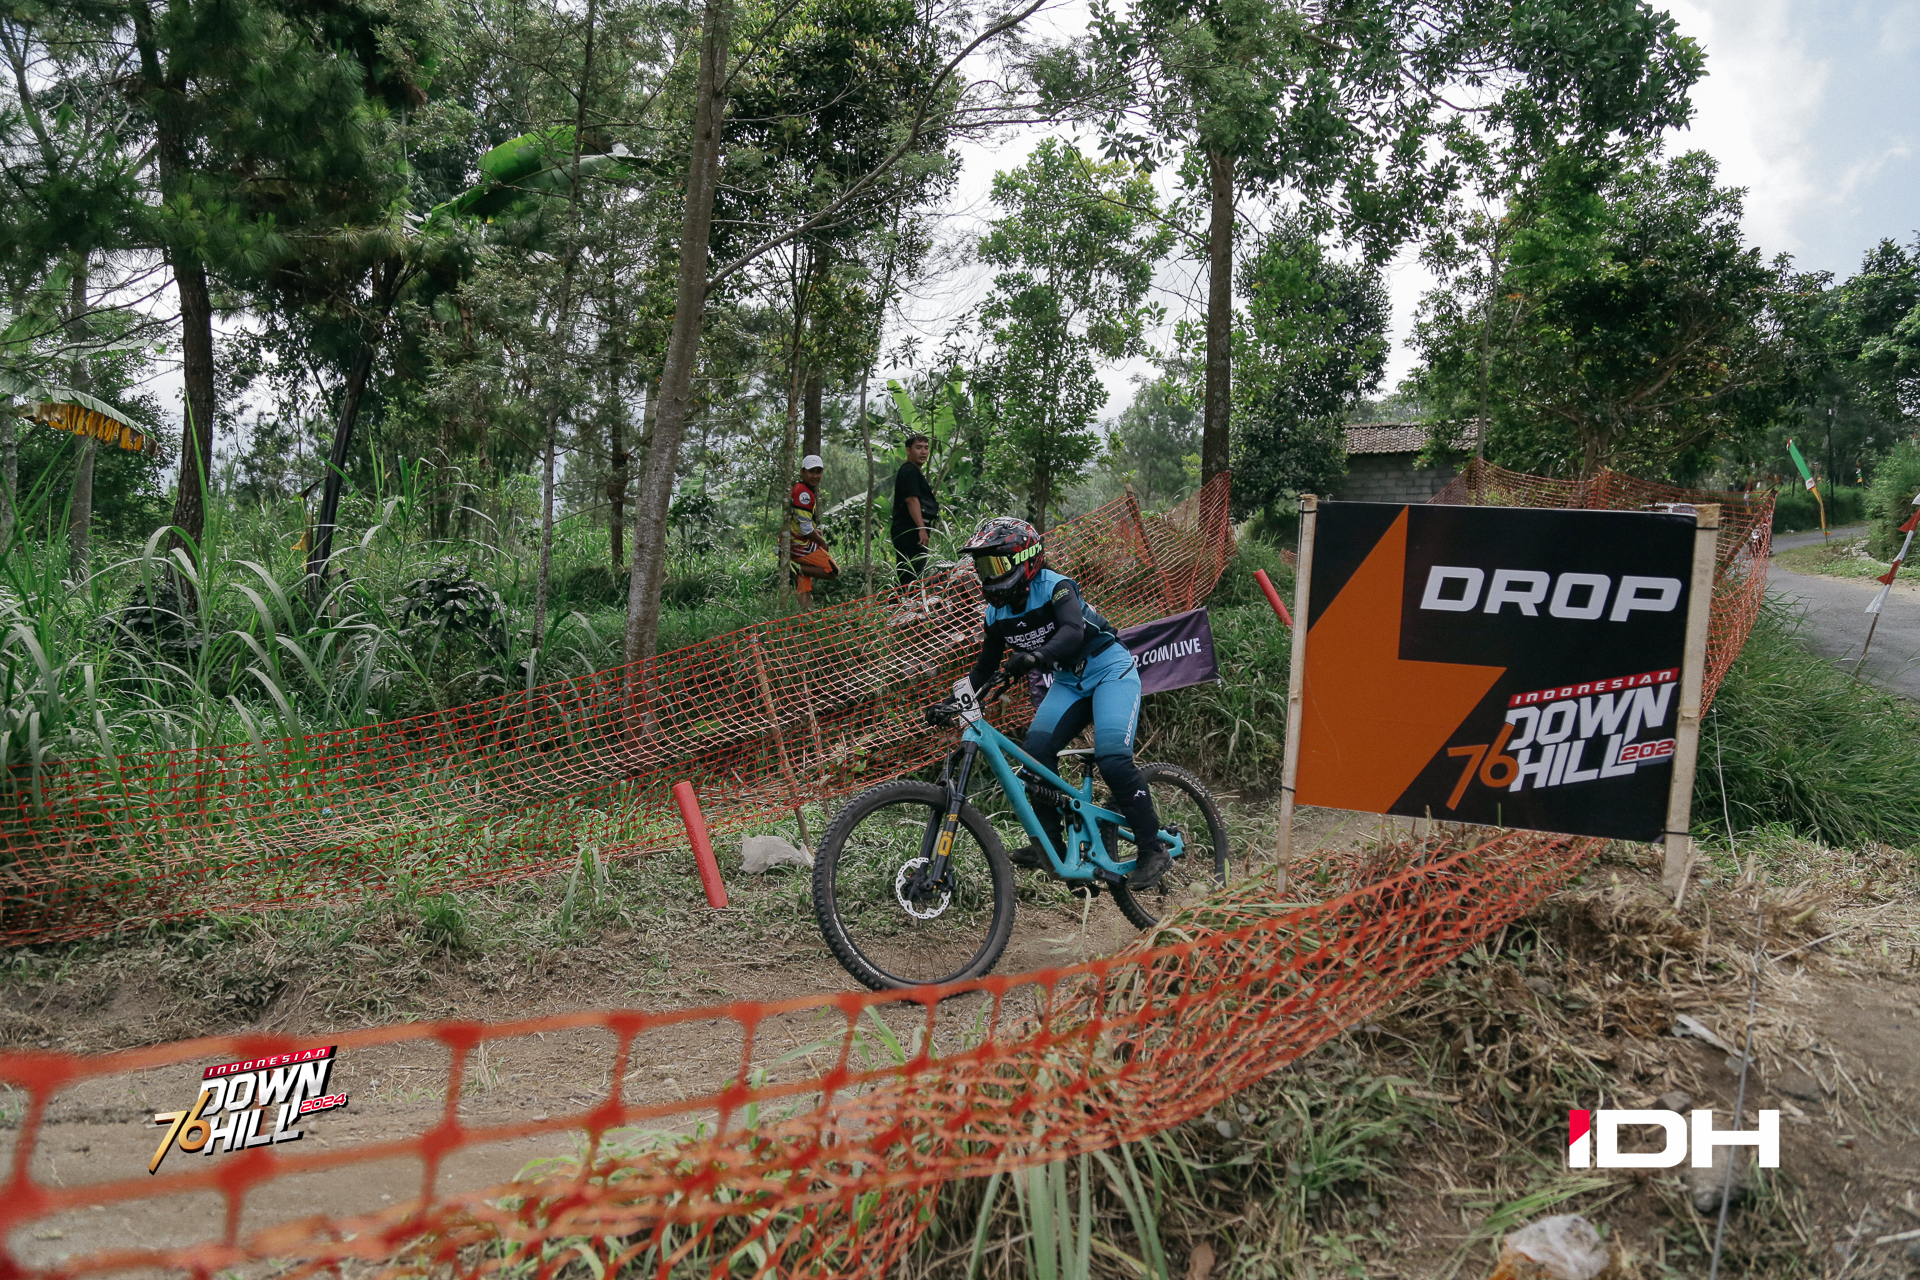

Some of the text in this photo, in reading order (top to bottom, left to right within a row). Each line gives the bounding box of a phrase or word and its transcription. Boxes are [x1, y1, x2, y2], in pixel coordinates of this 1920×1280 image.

[1012, 541, 1042, 565] 100%
[1420, 565, 1682, 622] DROP
[1025, 622, 1055, 640] CIBUBUR
[1514, 671, 1672, 704] INDONESIAN
[1505, 682, 1678, 751] DOWN
[1446, 722, 1520, 811] 76
[1509, 733, 1677, 793] HILL 202
[1180, 775, 1206, 798] MAZZA
[833, 913, 858, 956] MAZZA
